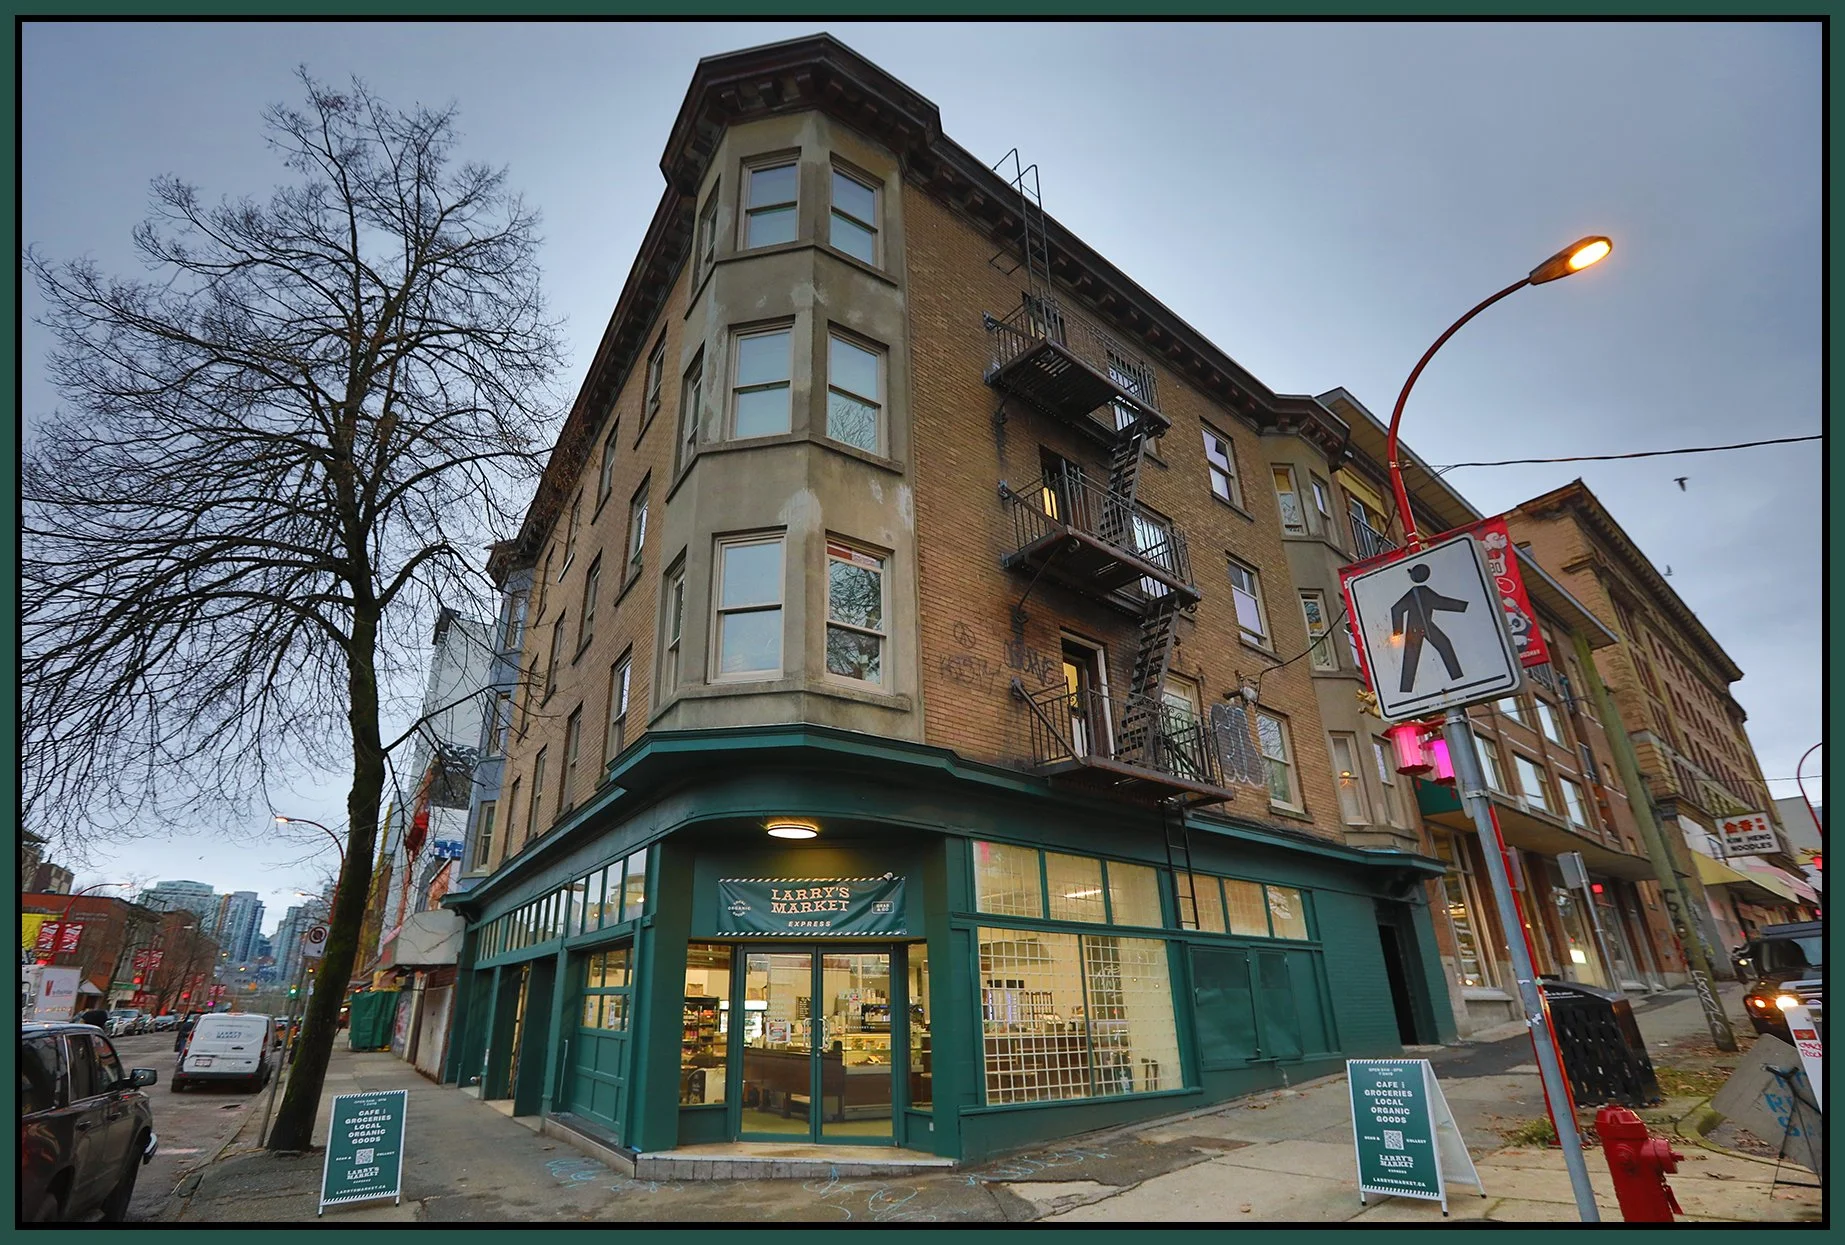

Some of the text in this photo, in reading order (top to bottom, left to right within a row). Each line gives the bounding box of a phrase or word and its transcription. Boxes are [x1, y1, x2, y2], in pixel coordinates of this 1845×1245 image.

[1730, 842, 1772, 851] NOODLES
[771, 886, 850, 900] LARRY'S
[771, 900, 850, 914] MARKET
[1364, 1090, 1413, 1098] GROCERIES
[1376, 1098, 1404, 1106] LOCAL
[345, 1114, 392, 1124] GROCERIES
[1376, 1116, 1406, 1124] GOODS
[348, 1129, 386, 1138] ORGANIC
[352, 1136, 381, 1144] GOODS
[1379, 1154, 1414, 1162] LARRY'S
[1380, 1160, 1414, 1168] MARKET
[348, 1166, 380, 1175] LARRY'S
[346, 1172, 378, 1180] MARKET
